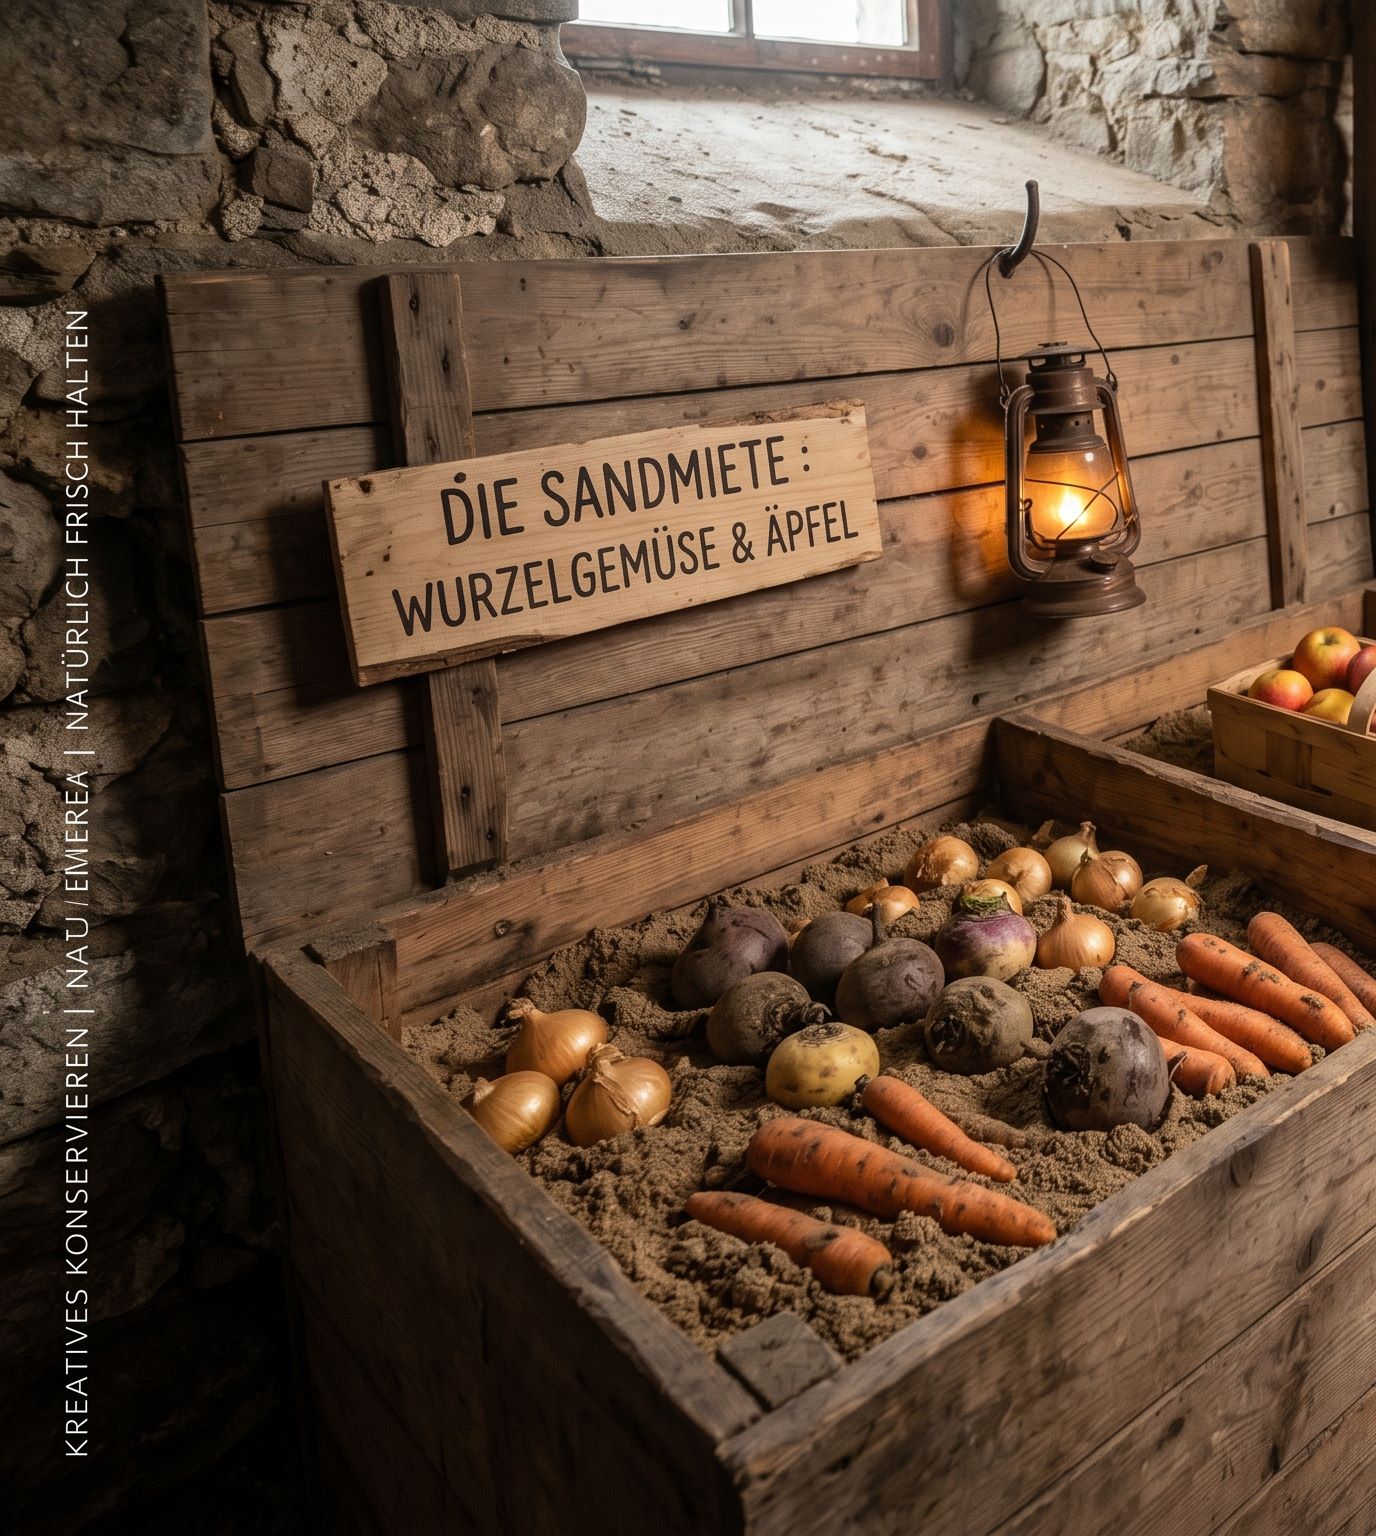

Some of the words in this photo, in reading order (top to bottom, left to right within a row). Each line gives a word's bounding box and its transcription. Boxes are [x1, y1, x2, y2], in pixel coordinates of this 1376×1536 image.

[440, 476, 526, 547] DIE
[541, 435, 790, 528] SANDMIETE
[391, 525, 721, 638] WURZELGEMÜSE
[731, 521, 755, 564] &
[765, 499, 860, 558] ÄPFEL
